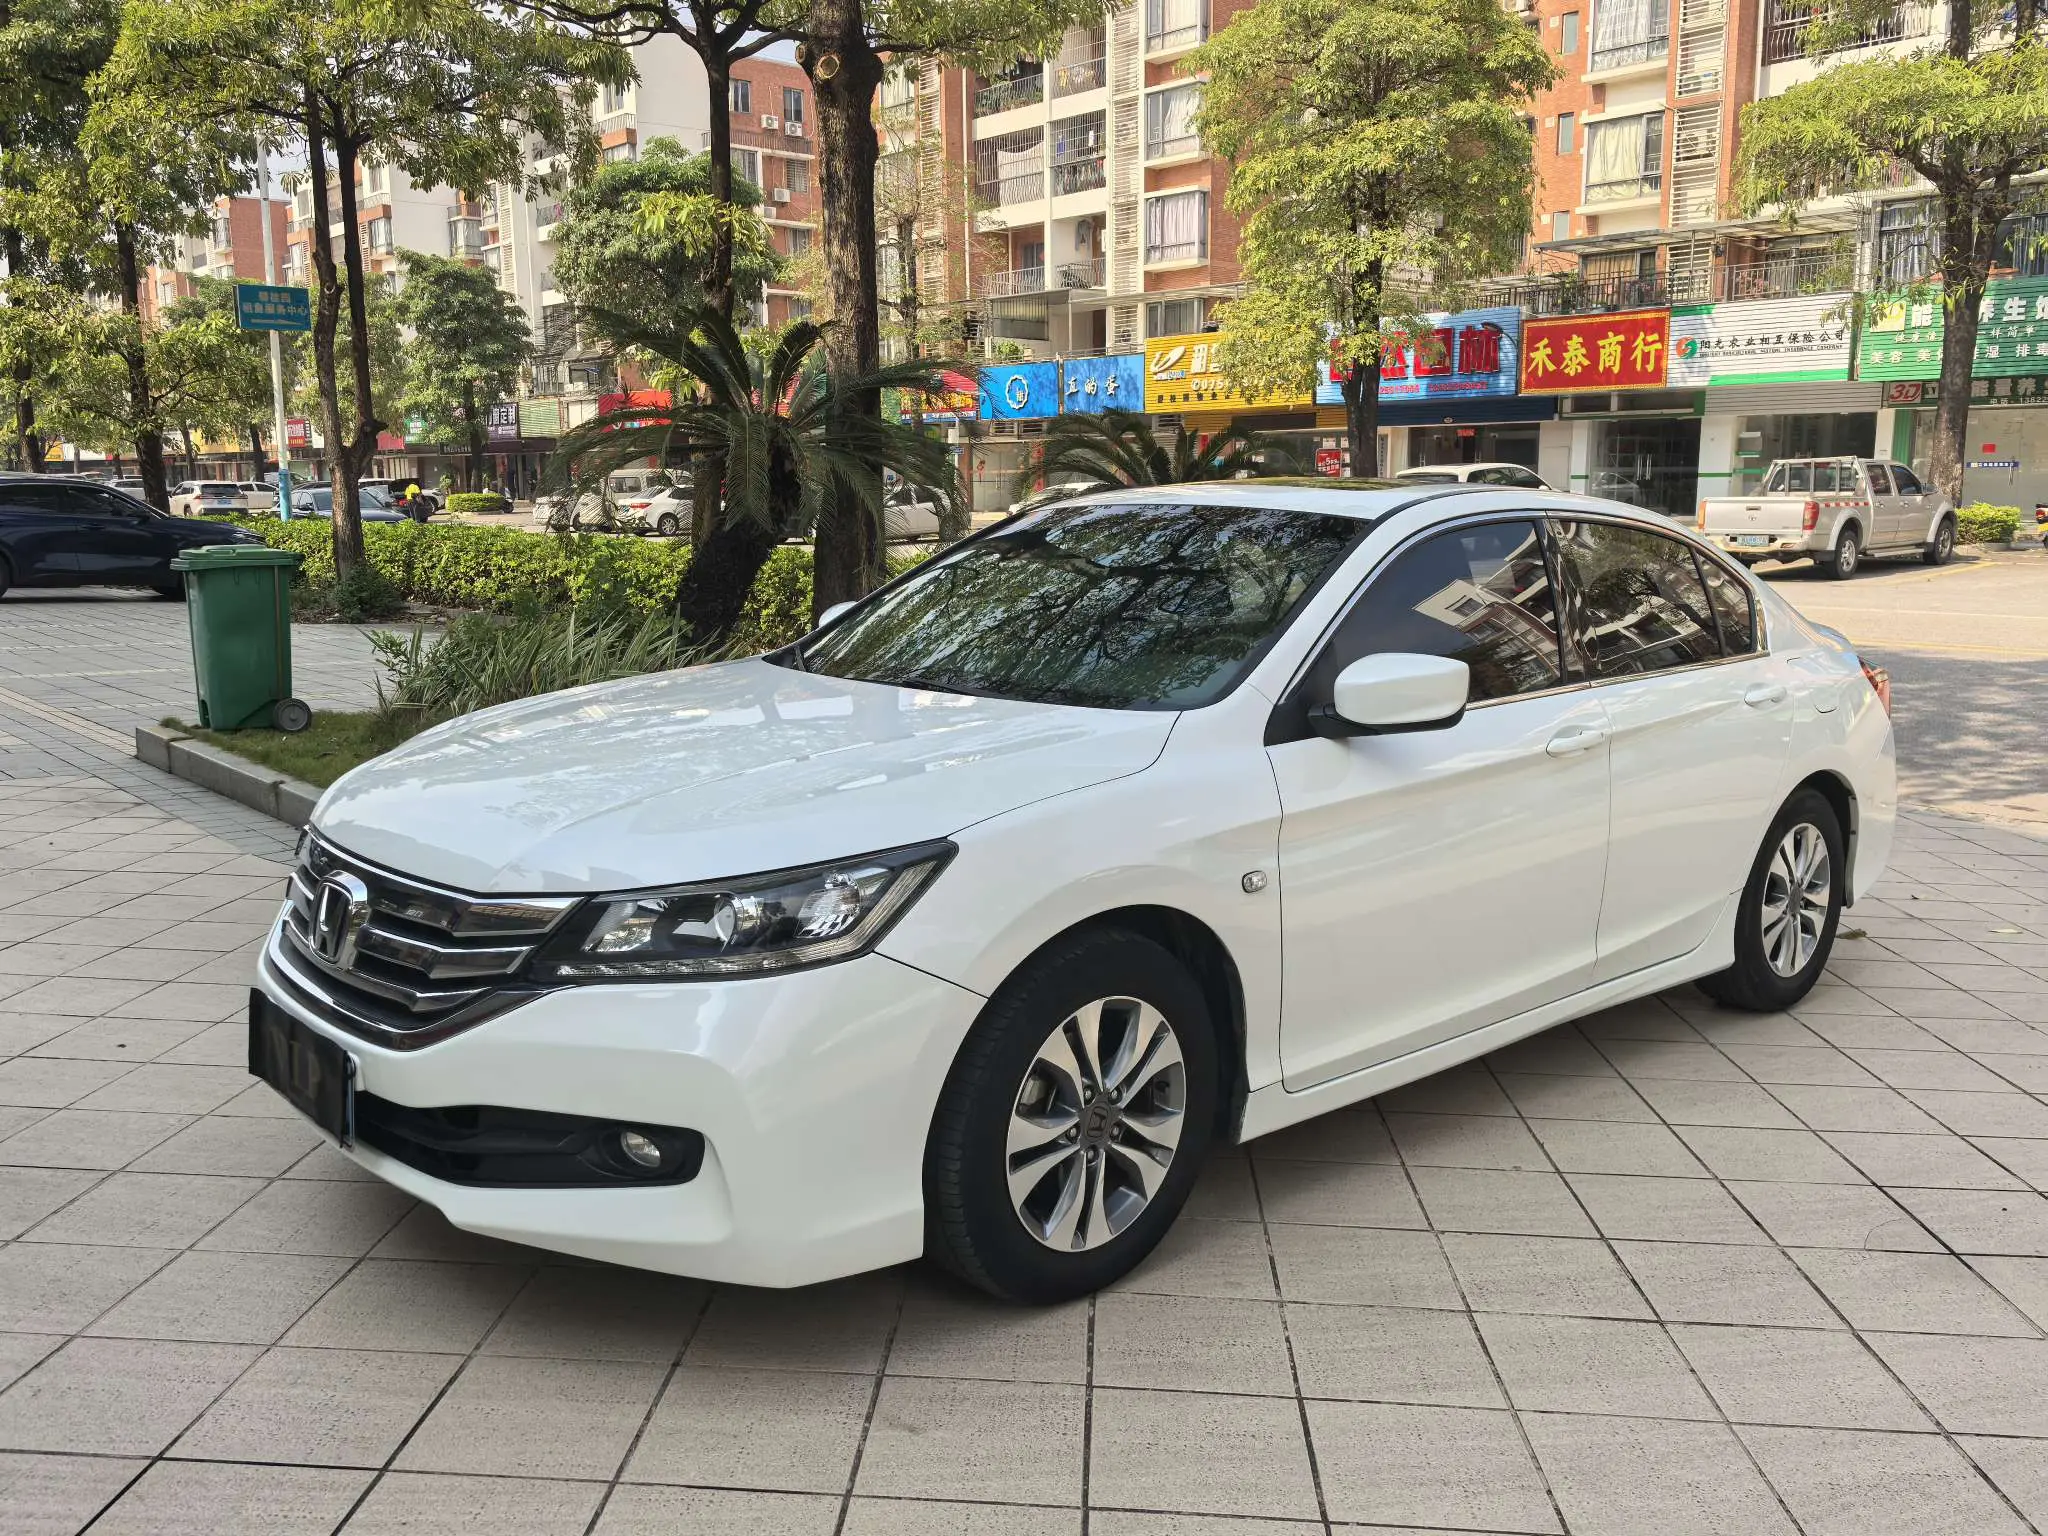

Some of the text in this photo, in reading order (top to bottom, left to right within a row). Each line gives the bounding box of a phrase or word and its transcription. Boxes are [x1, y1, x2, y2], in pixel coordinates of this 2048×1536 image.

[1700, 329, 1845, 349] 阳光农业相互保险公司
[1528, 331, 1662, 377] 禾泰商行
[1889, 383, 1922, 401] 3D
